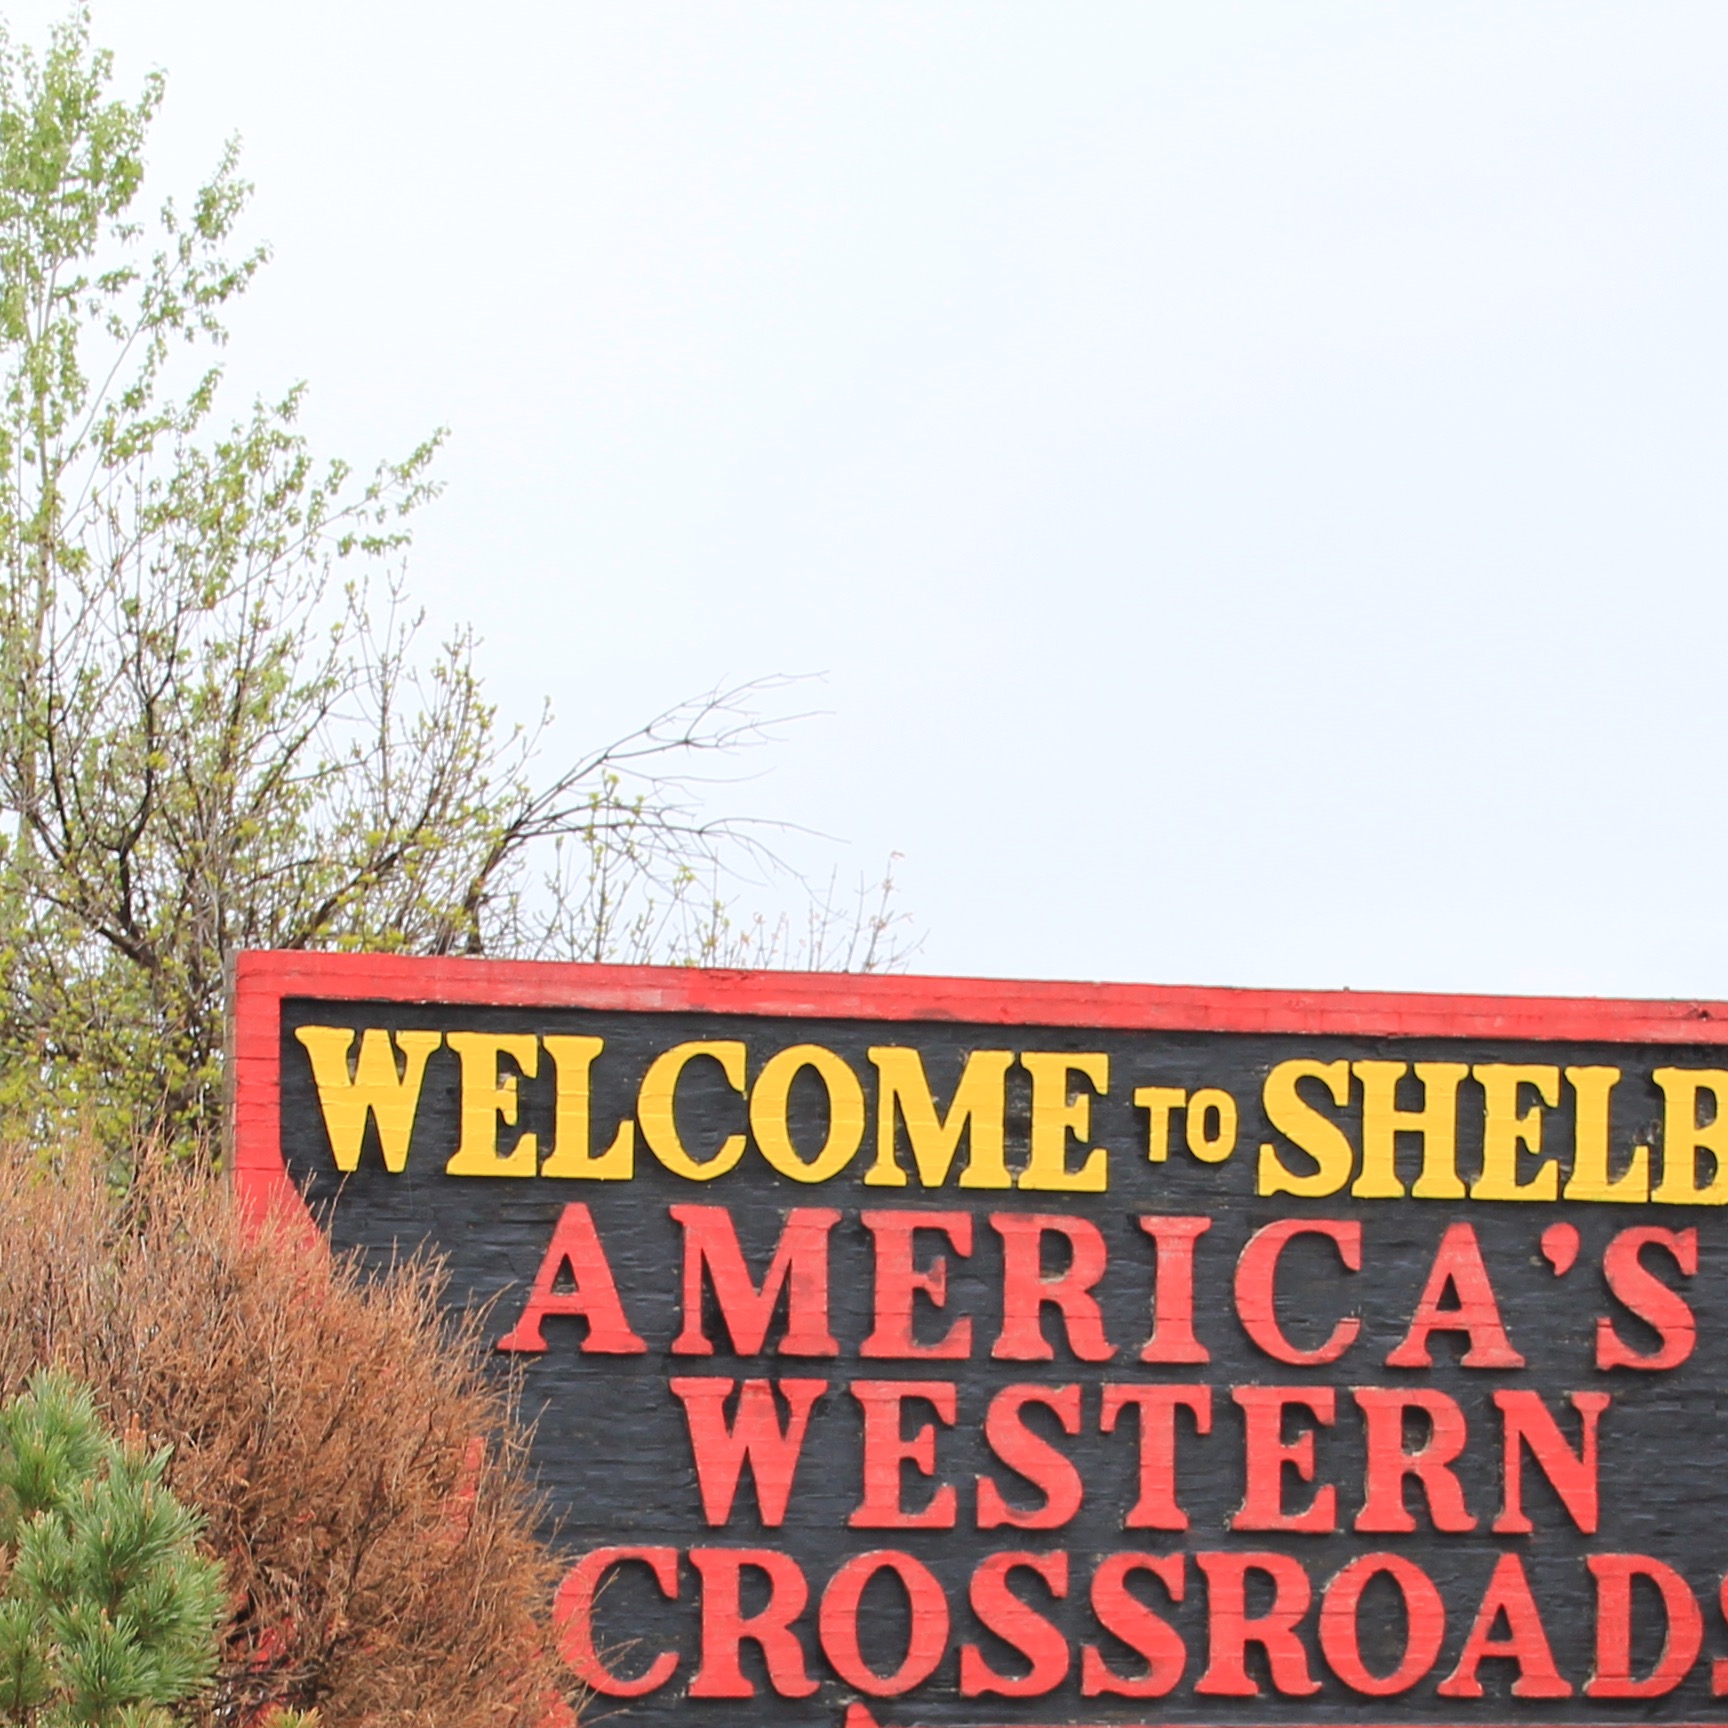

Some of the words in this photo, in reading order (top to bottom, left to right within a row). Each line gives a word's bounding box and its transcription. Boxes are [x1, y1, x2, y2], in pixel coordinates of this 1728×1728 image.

[295, 1025, 1109, 1192] WELCOME
[1134, 1086, 1238, 1163] TO
[497, 1201, 1699, 1371] AMERICA'S
[669, 1376, 1612, 1535] WESTERN
